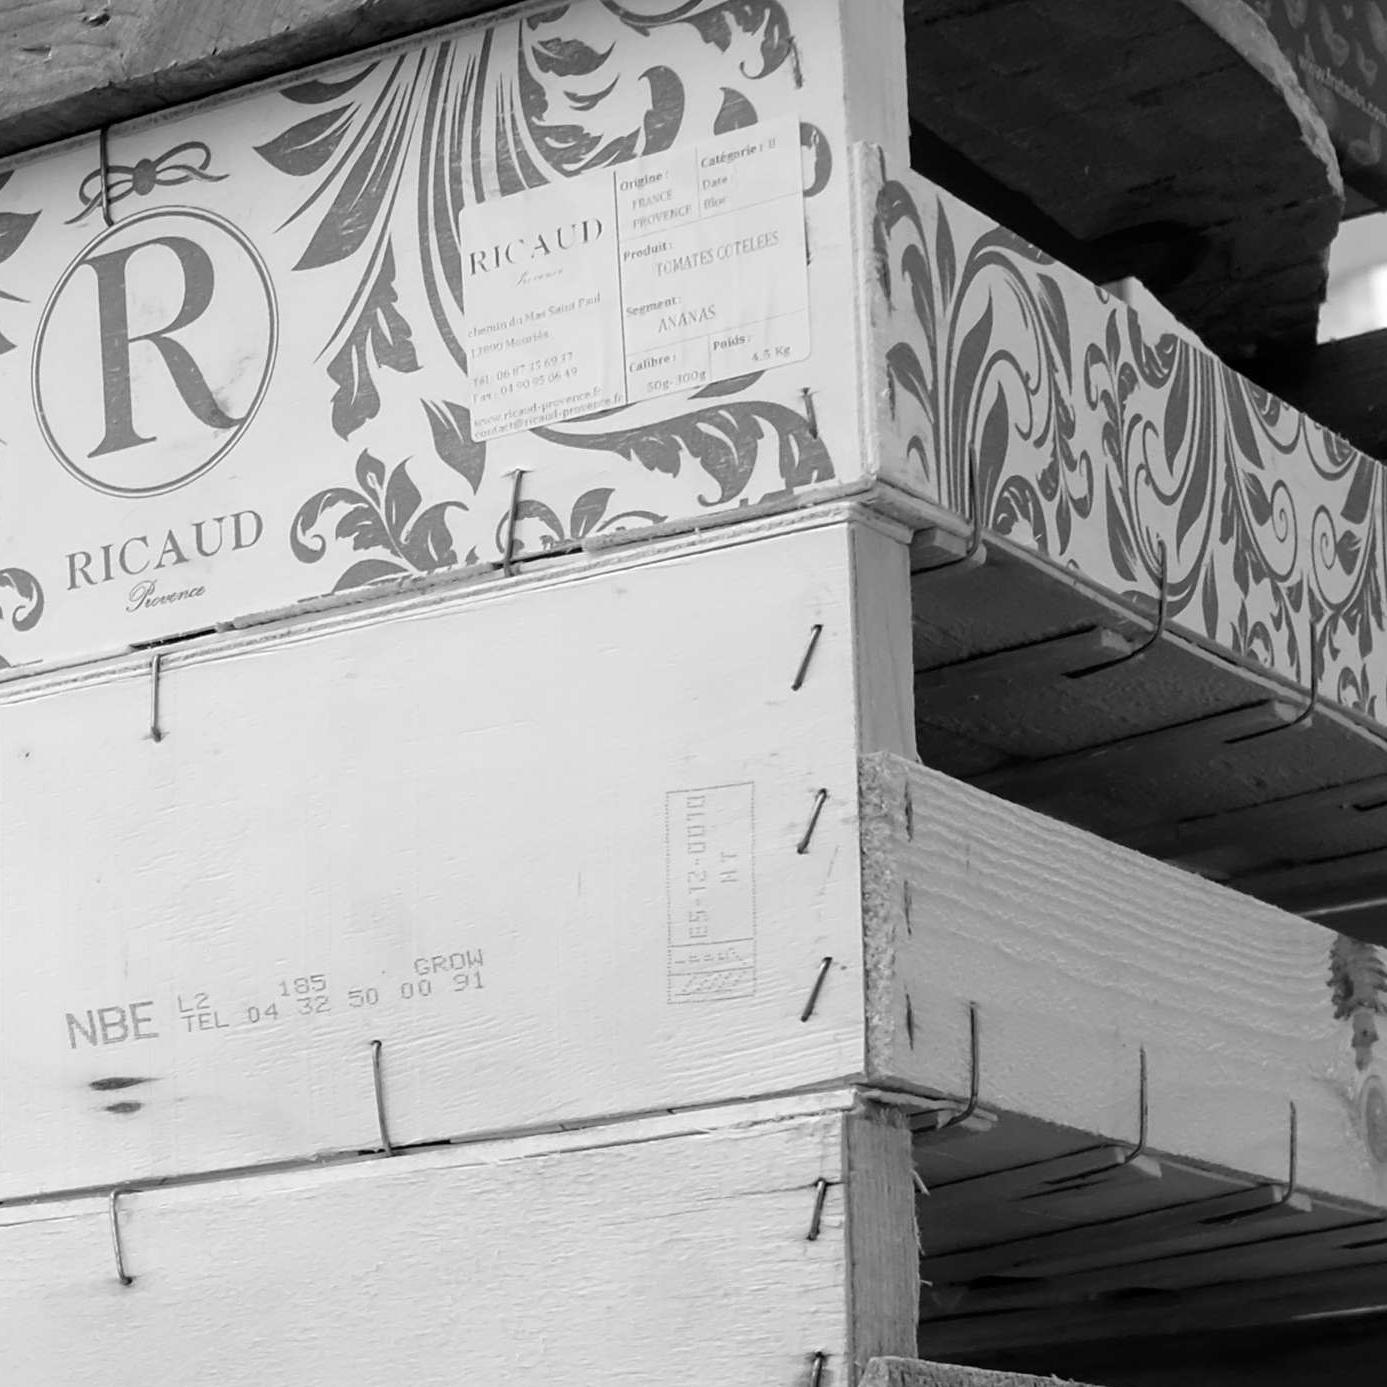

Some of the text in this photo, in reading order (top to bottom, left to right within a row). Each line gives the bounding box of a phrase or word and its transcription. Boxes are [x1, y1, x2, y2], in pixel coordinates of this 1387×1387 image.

[468, 217, 604, 277] RICAUD
[655, 249, 715, 279] TOMATES
[79, 235, 246, 459] R
[657, 304, 716, 334] ANANAS
[65, 509, 264, 592] RICAUD
[125, 578, 207, 614] Provence
[66, 999, 161, 1050] NBE
[176, 991, 211, 1014] L2
[279, 972, 328, 999] 185
[180, 969, 486, 1033] TEL 04 32 50 00 91
